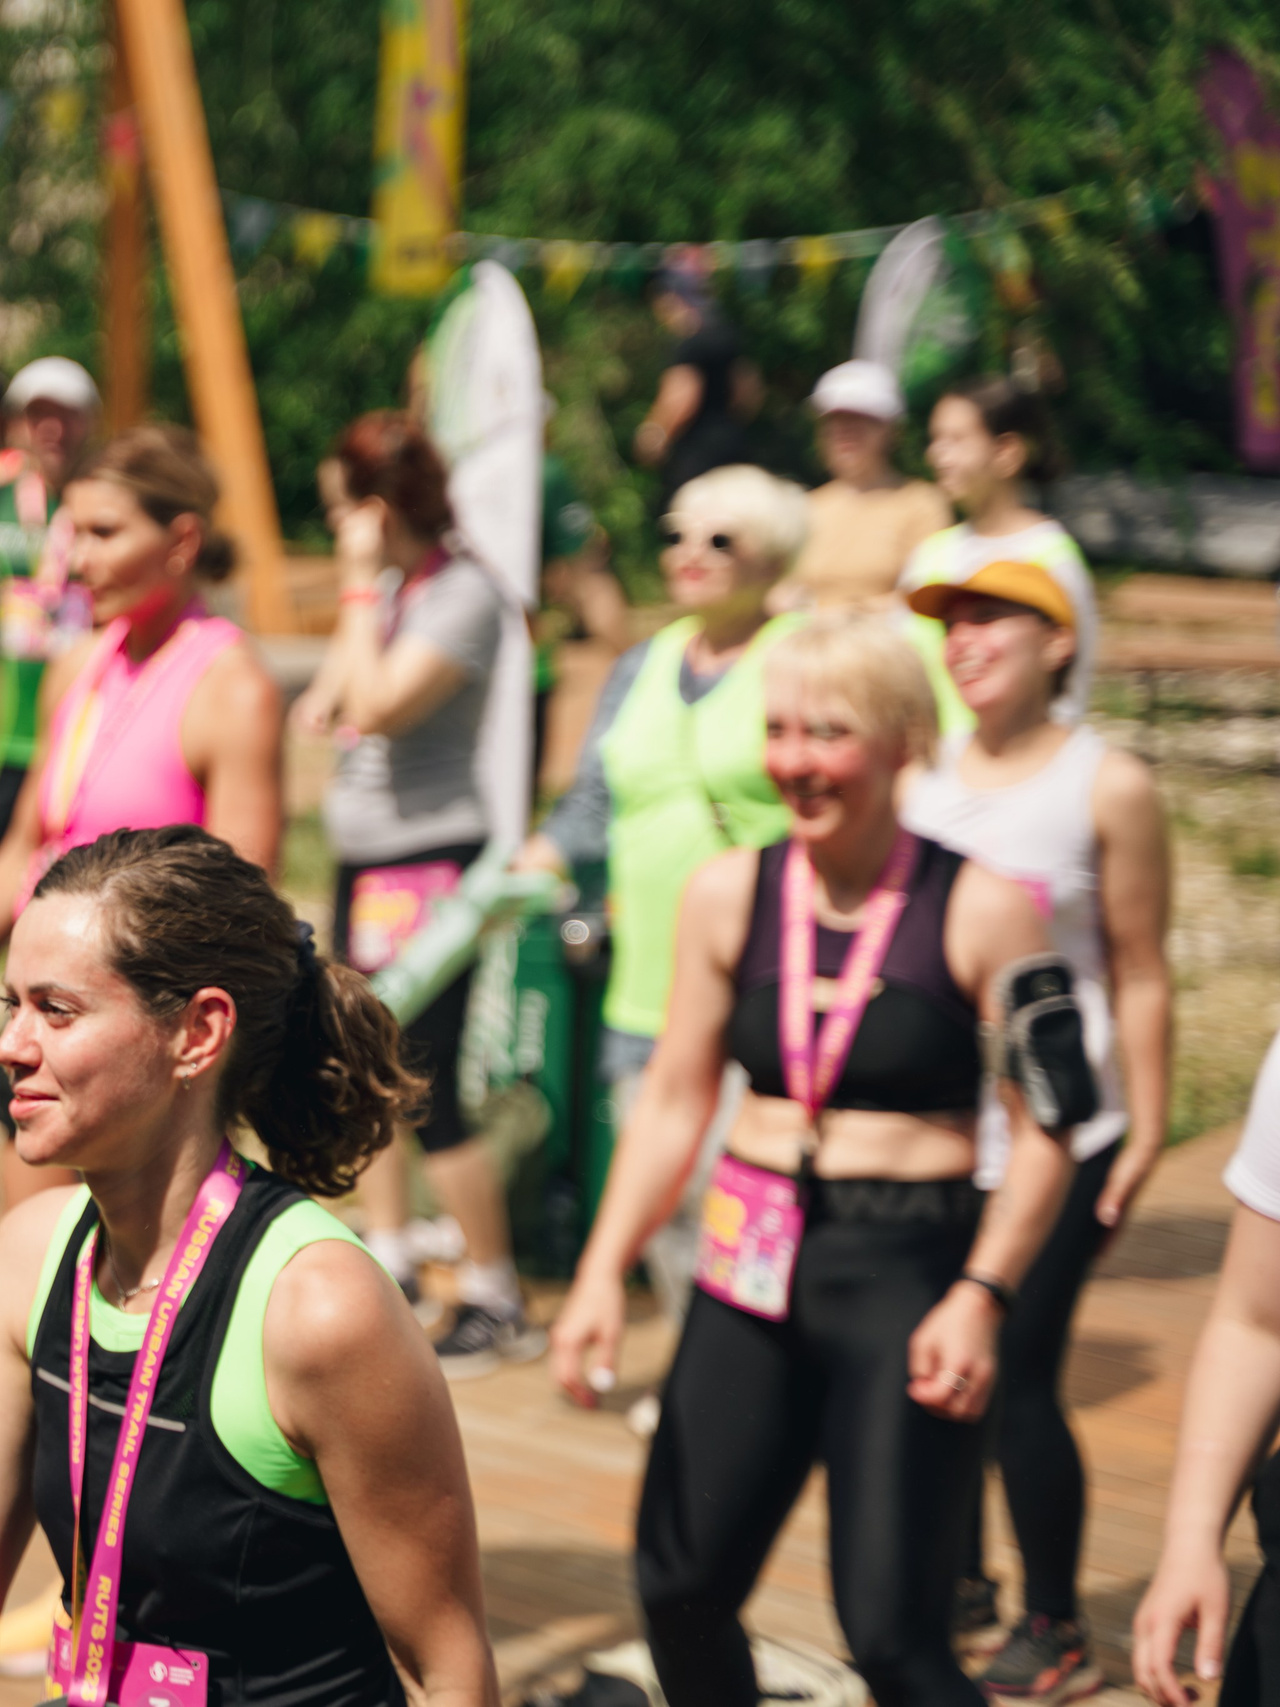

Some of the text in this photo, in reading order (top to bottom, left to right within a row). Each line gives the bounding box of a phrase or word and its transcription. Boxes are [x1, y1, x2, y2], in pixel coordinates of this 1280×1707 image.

[104, 1199, 225, 1548] RUSSIAN URBAN TRAIL SERIES
[91, 1575, 112, 1640] RUTS
